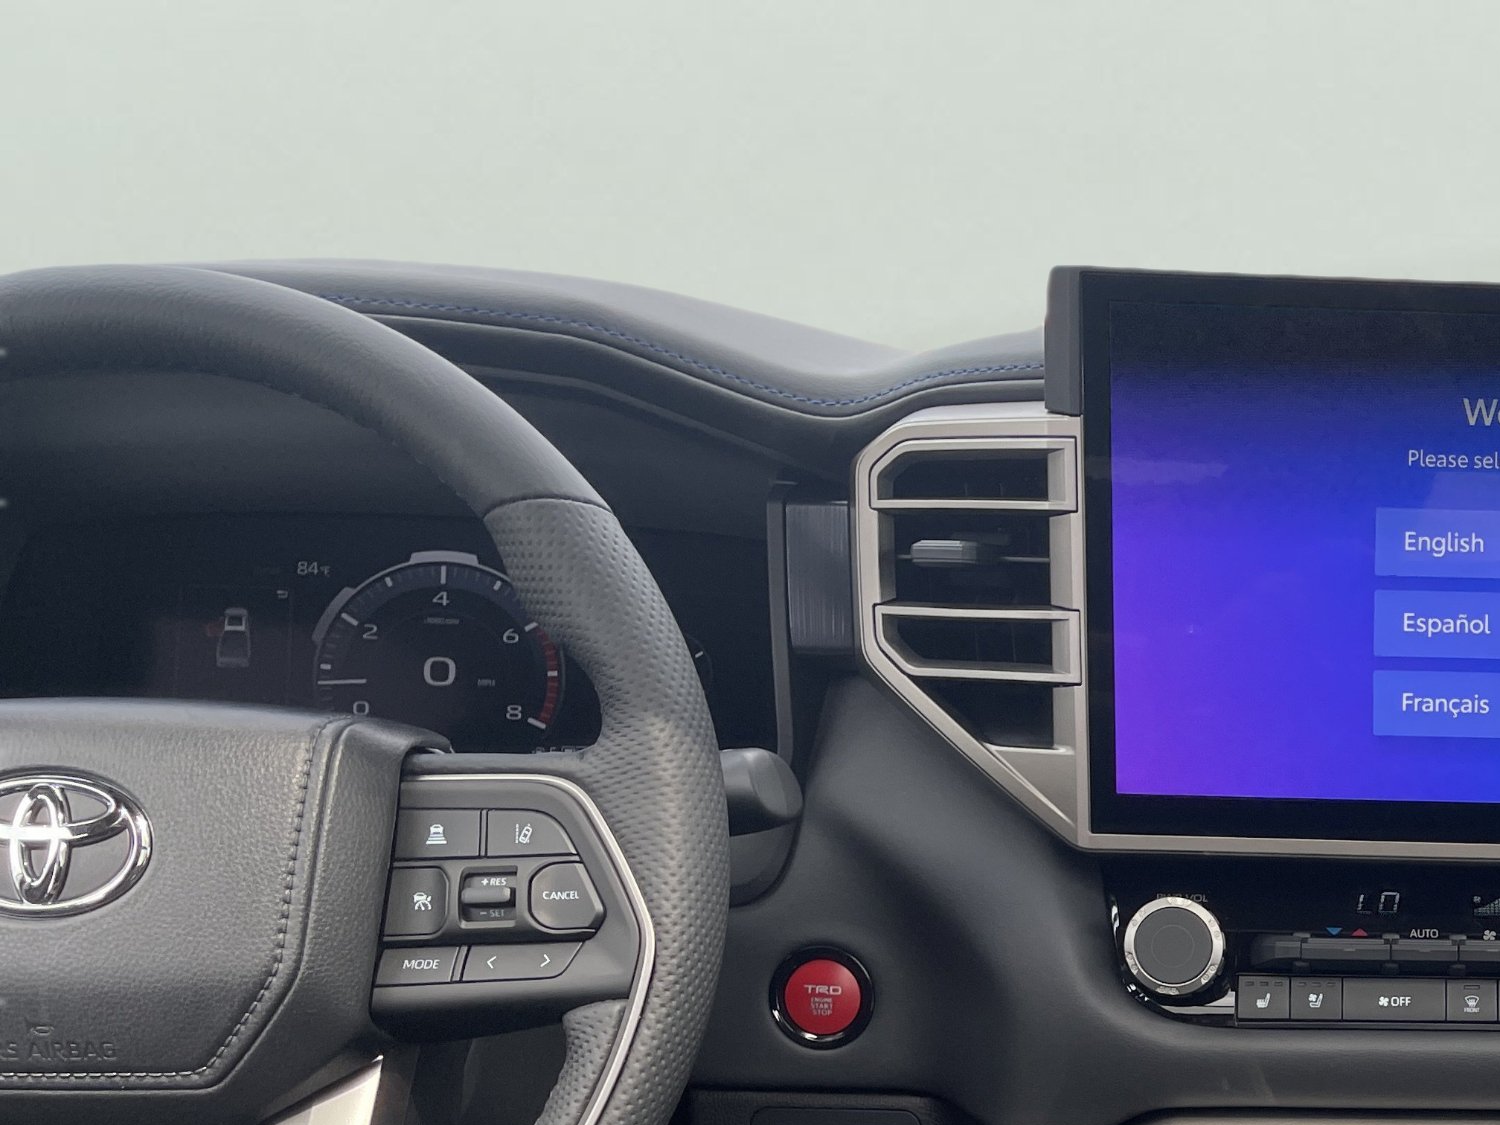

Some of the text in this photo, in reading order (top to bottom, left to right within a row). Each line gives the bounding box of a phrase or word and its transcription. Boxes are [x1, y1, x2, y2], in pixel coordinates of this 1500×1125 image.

[1407, 450, 1469, 469] Please
[1404, 531, 1485, 557] English
[432, 591, 450, 606] 4
[362, 624, 378, 640] 2
[1402, 612, 1491, 638] Español
[502, 628, 519, 644] 6
[423, 656, 457, 686] 0
[352, 700, 370, 716] 0
[505, 704, 522, 720] 8
[1401, 692, 1490, 719] Français
[542, 890, 580, 900] CANCEL
[1409, 928, 1439, 939] AUTO
[402, 959, 440, 970] MODE
[803, 984, 842, 995] TRD
[1390, 997, 1411, 1007] OFF
[28, 1043, 118, 1060] AIRBAG
